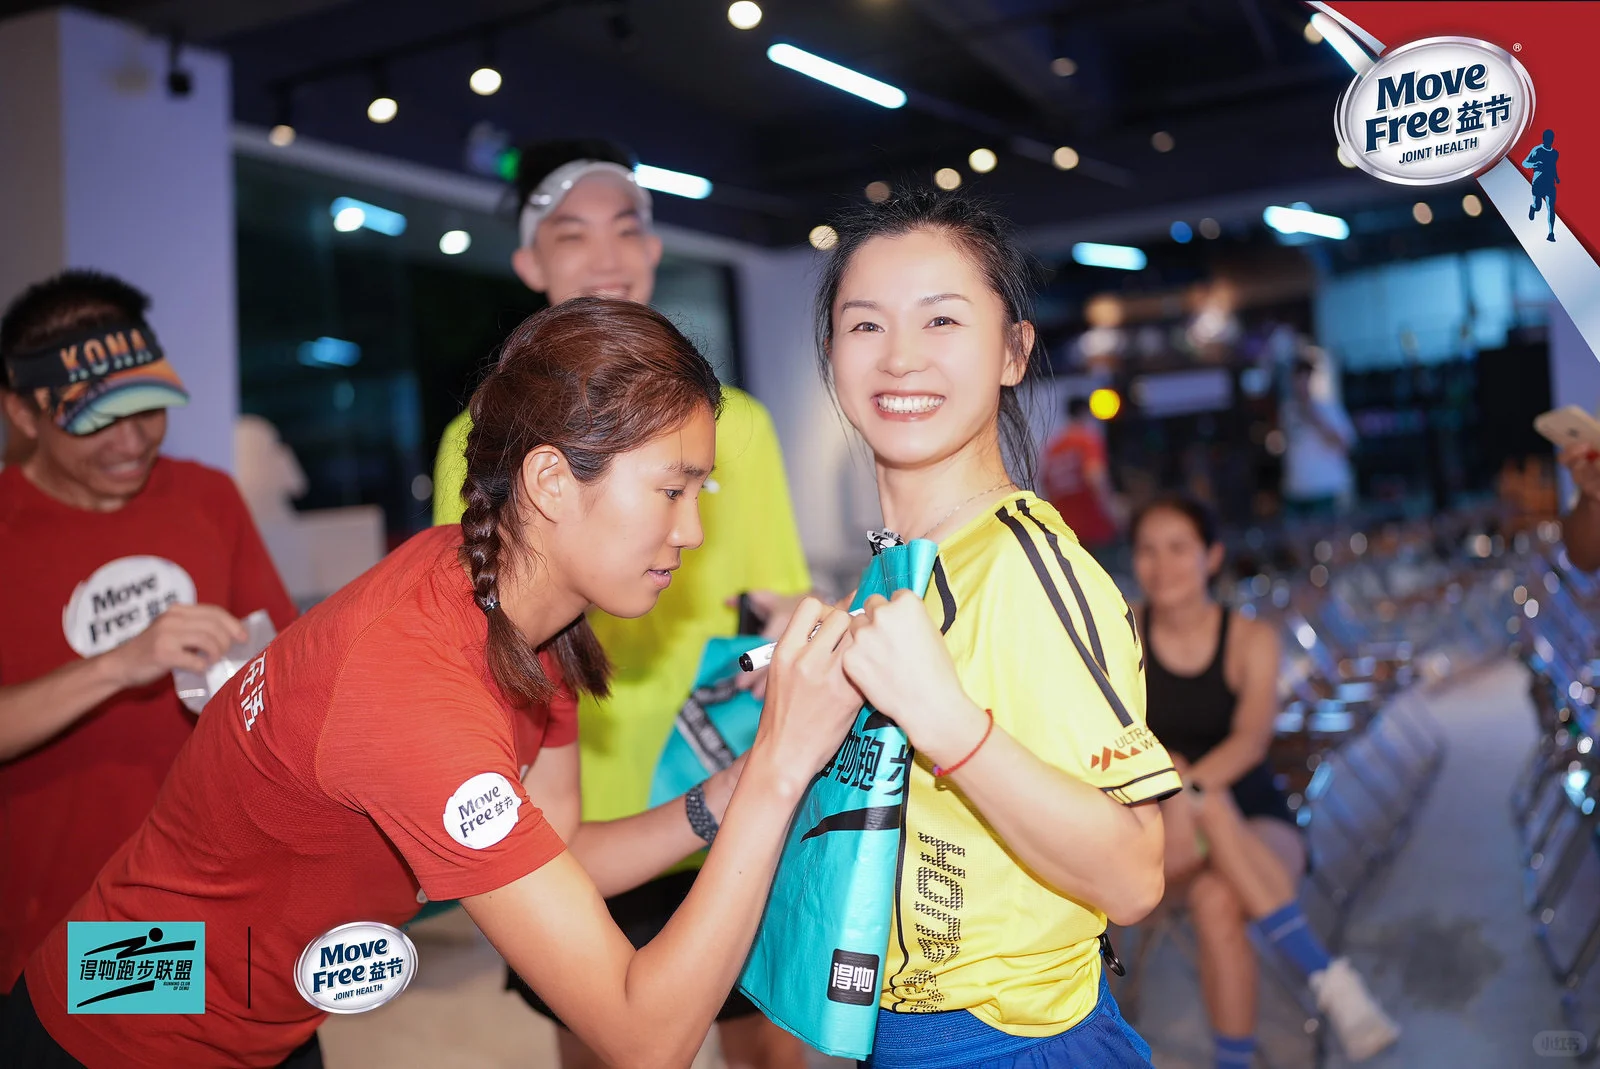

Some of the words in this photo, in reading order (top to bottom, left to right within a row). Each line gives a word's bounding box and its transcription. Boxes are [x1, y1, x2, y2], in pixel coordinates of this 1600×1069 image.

[92, 574, 157, 614] Move
[89, 606, 140, 644] Free
[458, 785, 501, 820] Move
[460, 808, 494, 838] Free
[494, 796, 513, 817] 益节
[832, 962, 875, 993] 得物
